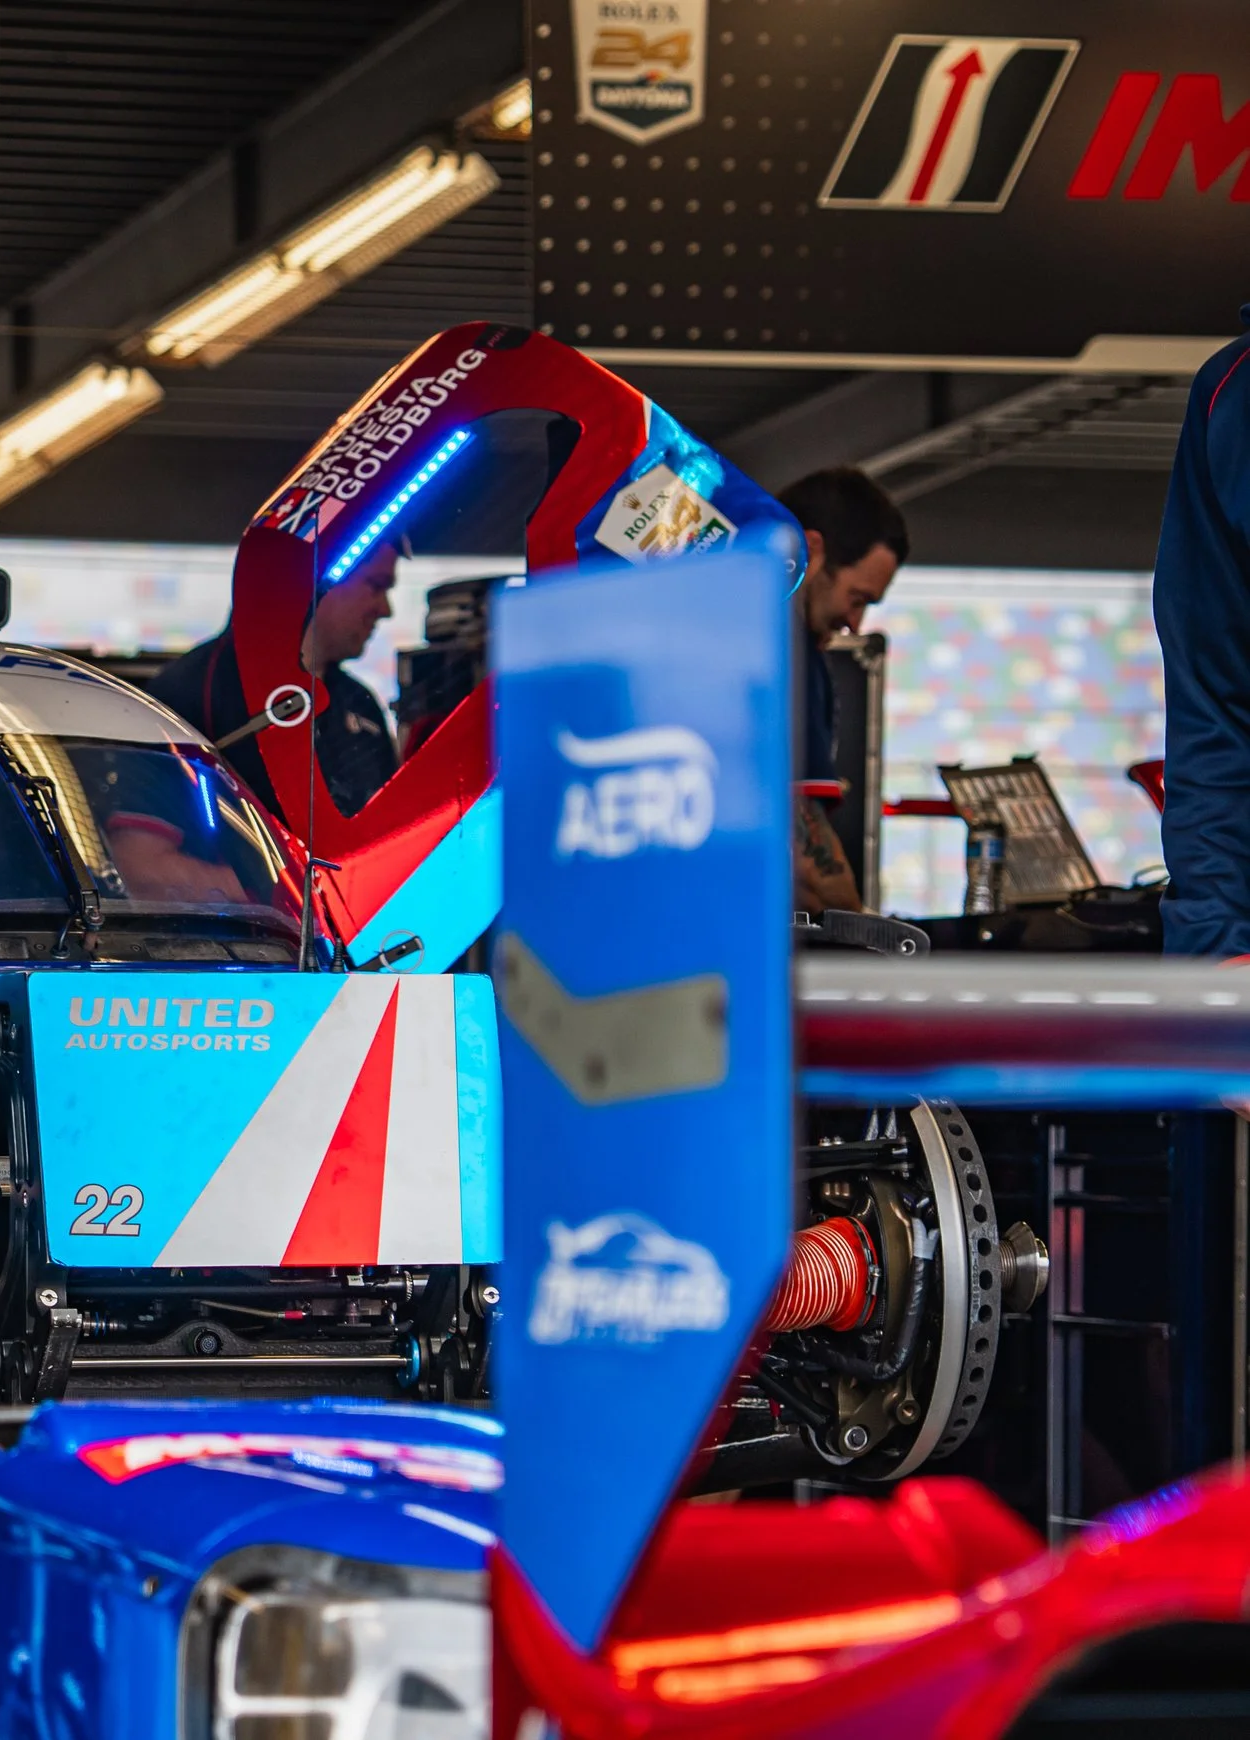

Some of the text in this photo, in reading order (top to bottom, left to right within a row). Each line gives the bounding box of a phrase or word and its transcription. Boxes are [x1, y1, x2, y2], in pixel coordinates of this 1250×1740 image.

[589, 28, 693, 69] 24
[314, 465, 350, 493] DI
[345, 376, 436, 460] RESTA
[335, 348, 487, 500] GOLDBURG
[623, 490, 670, 541] ROLEX
[555, 765, 714, 858] AERO
[69, 997, 275, 1028] UNITED
[65, 1033, 271, 1052] AUTOSPORTS
[69, 1183, 145, 1237] 22
